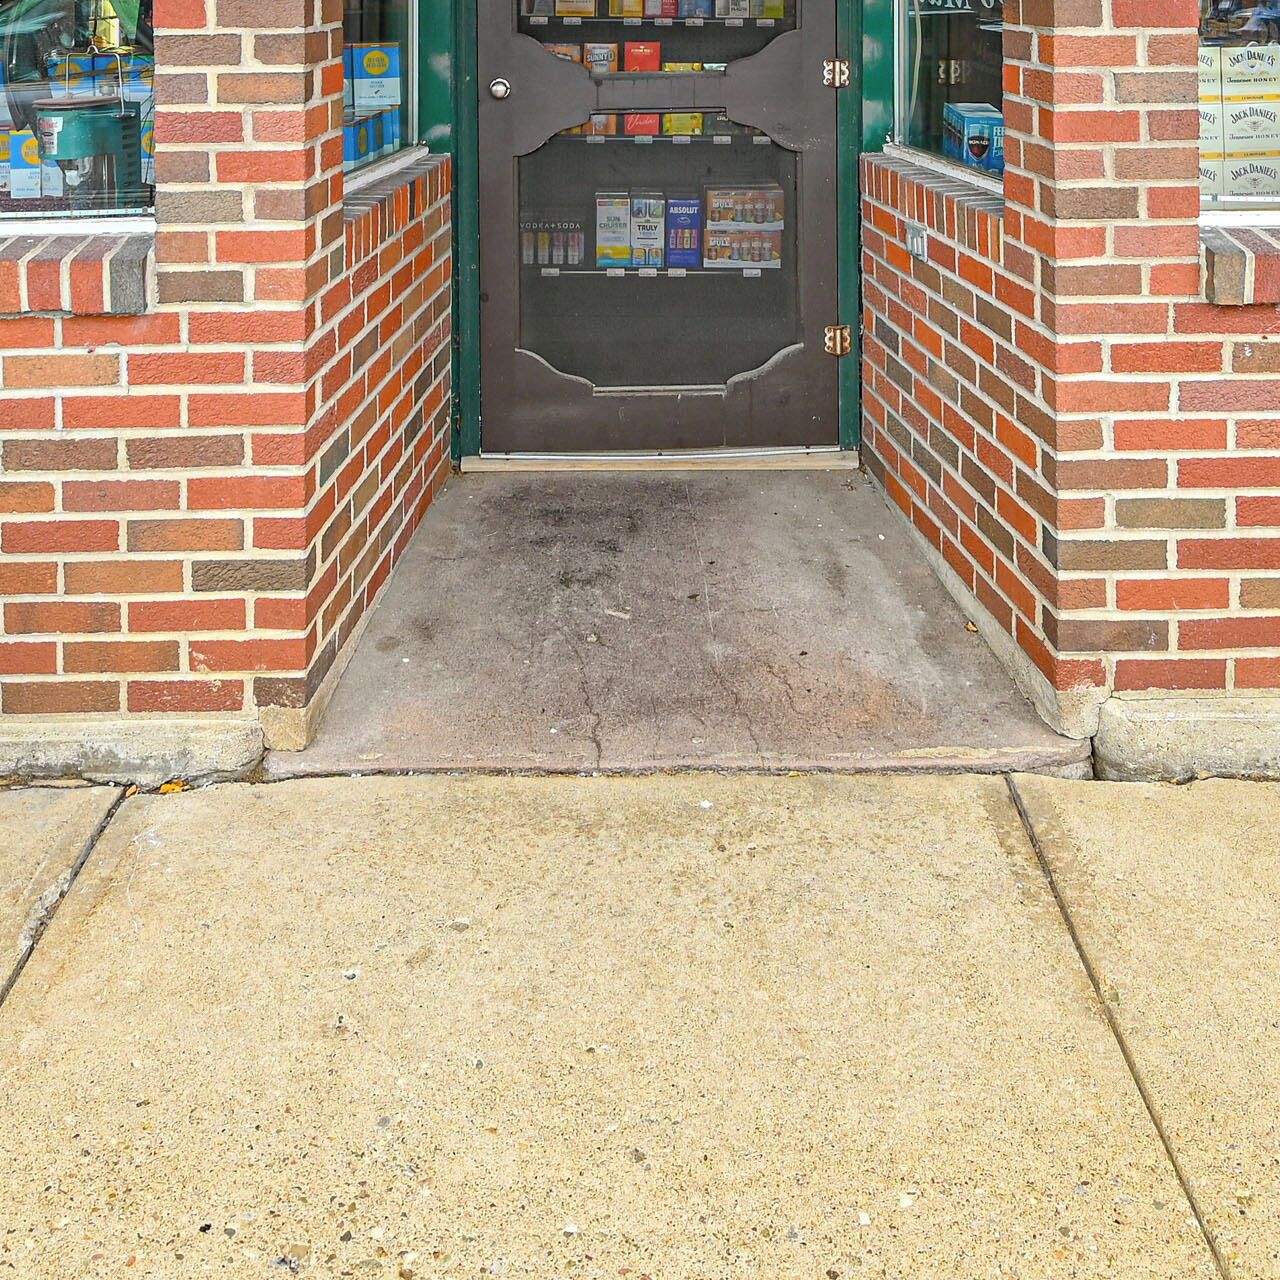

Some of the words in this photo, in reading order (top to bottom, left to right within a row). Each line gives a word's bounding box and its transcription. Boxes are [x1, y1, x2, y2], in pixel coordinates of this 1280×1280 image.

[1231, 108, 1248, 124] JACK
[1249, 107, 1277, 122] DANIEL'S
[1230, 165, 1248, 180] JACK
[1249, 163, 1278, 179] DANIEL'S
